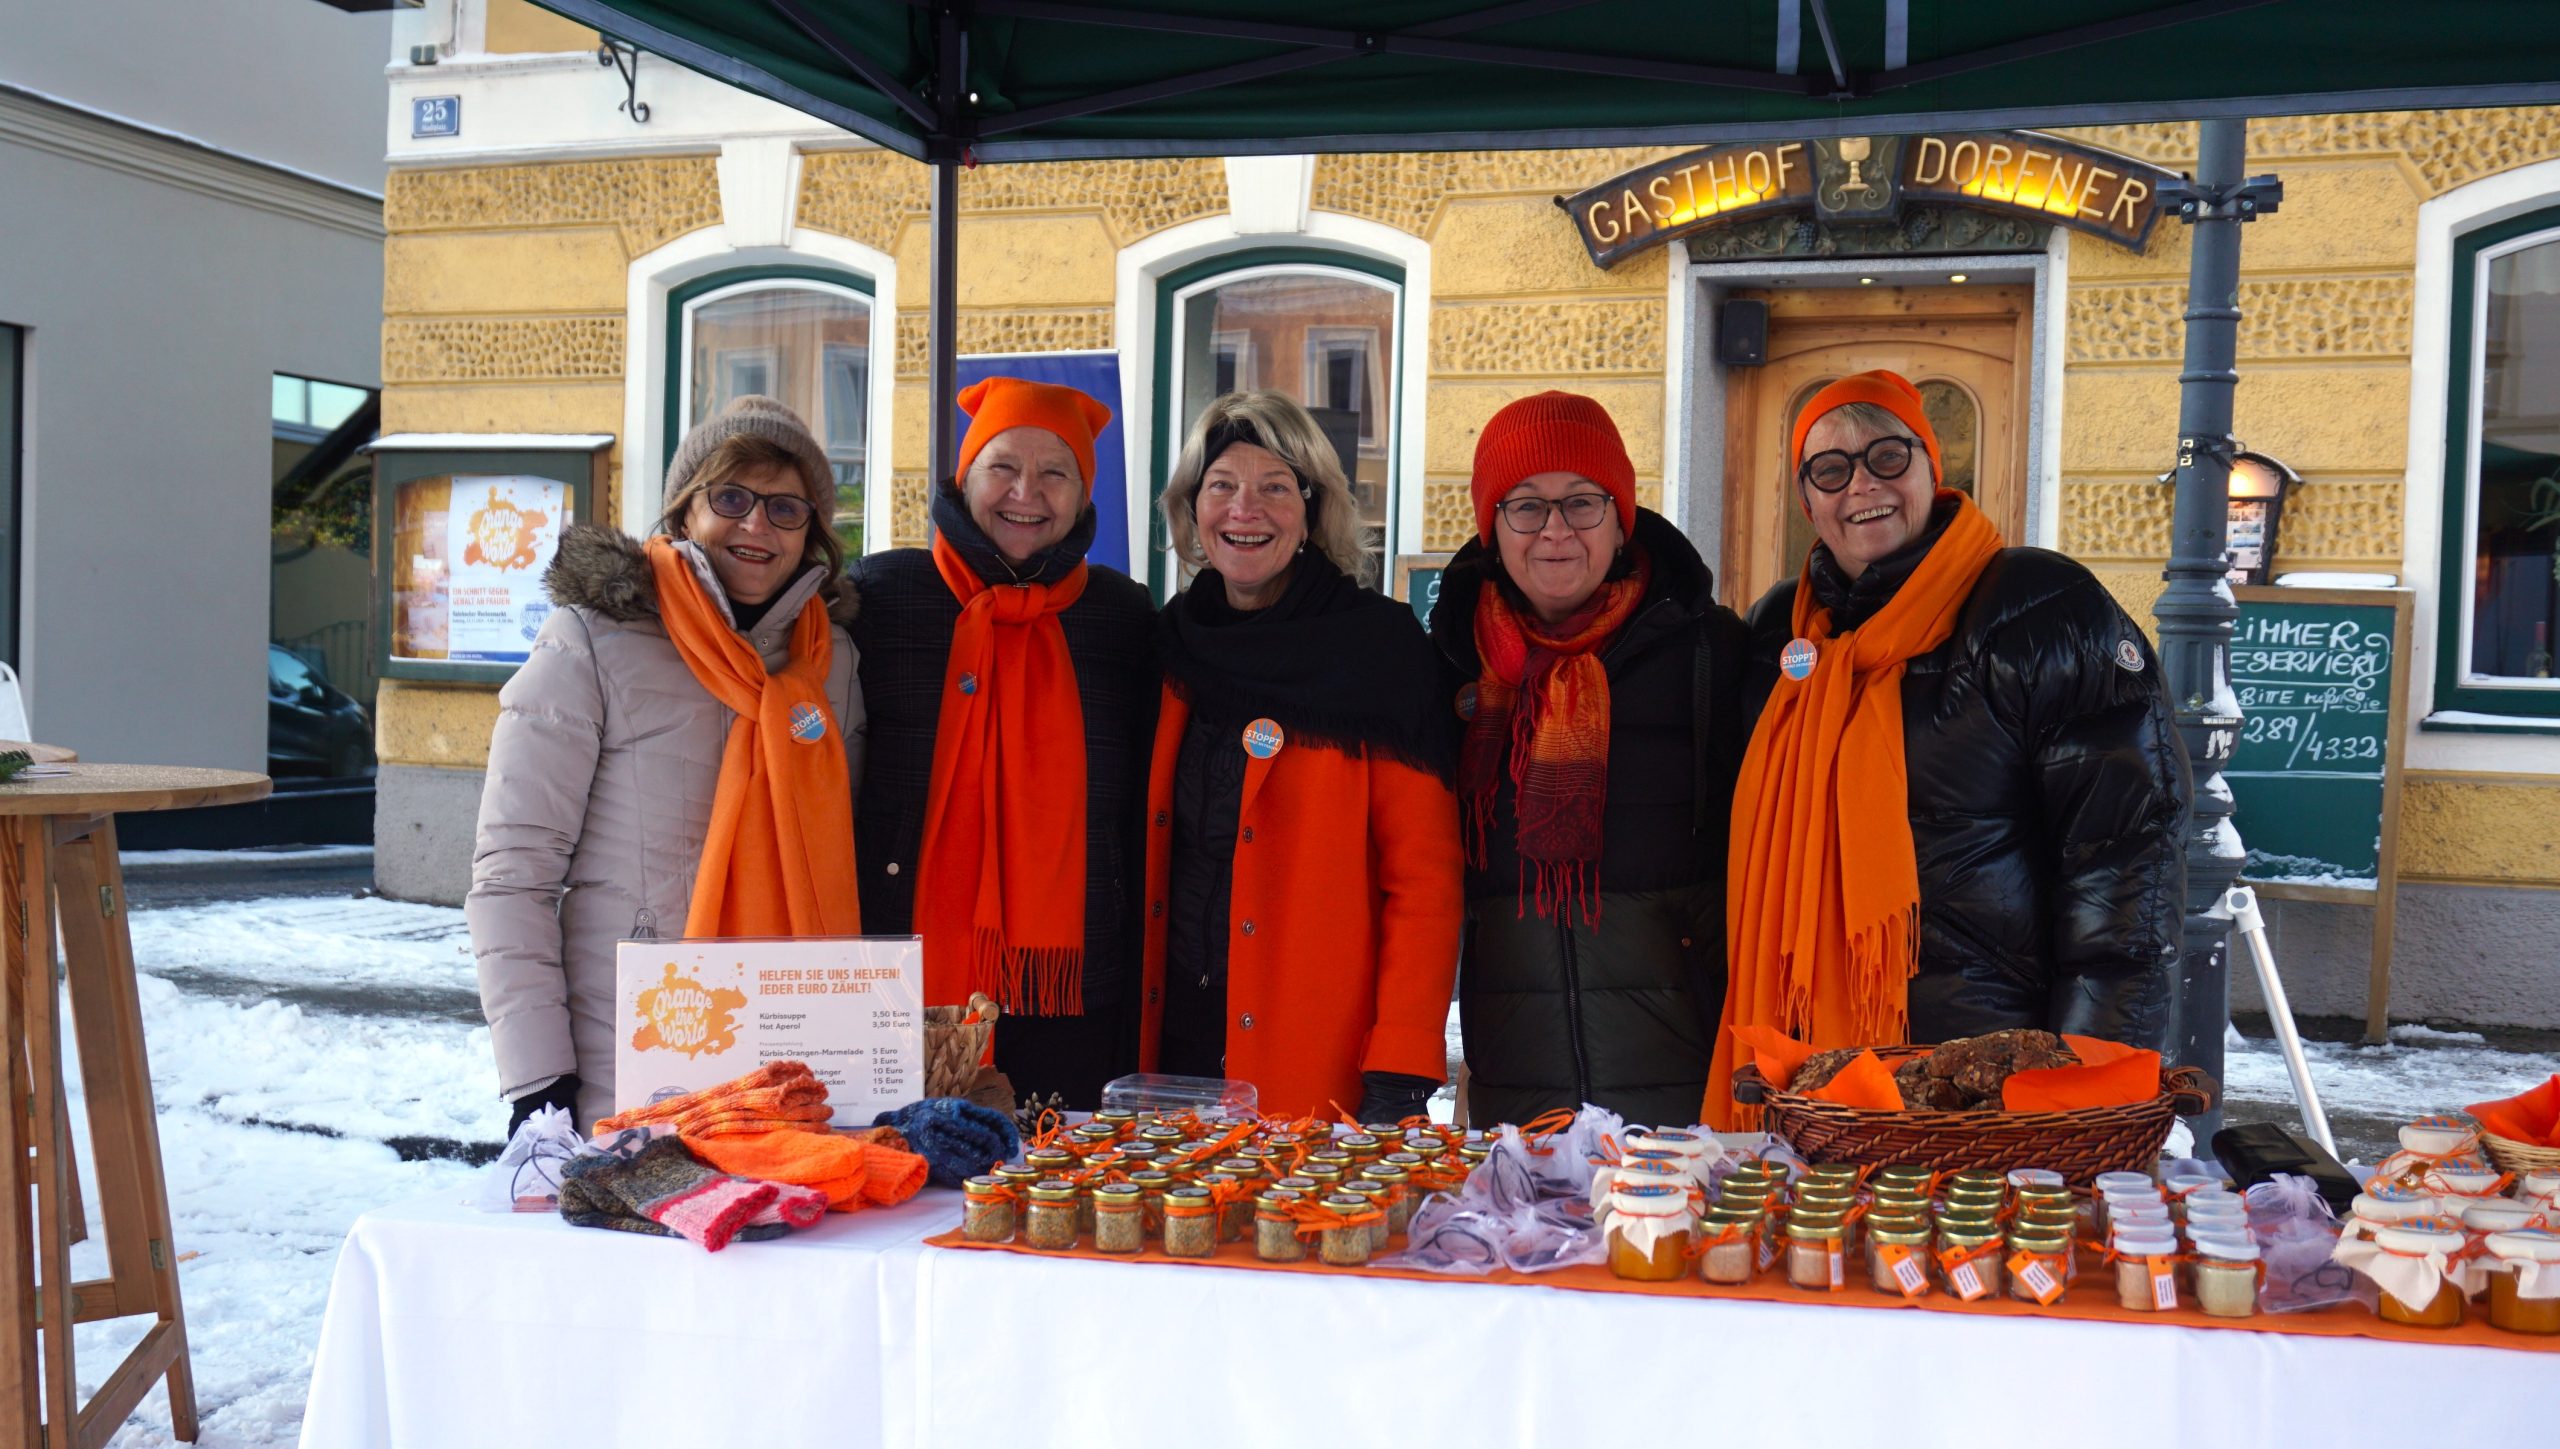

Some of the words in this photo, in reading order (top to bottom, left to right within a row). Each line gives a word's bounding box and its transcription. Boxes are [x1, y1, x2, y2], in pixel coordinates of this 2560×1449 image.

[422, 100, 448, 122] 25
[1588, 143, 1802, 243] GASTHOF
[1915, 137, 2149, 229] DORFNER
[2230, 617, 2360, 651] iMMER
[1783, 653, 1814, 665] STOPPT
[1459, 696, 1477, 708] STOP
[790, 709, 822, 735] STOPPT
[1246, 729, 1281, 746] STOPPT
[759, 970, 802, 981] HELFEN
[806, 969, 824, 980] SIE
[828, 969, 850, 980] UNS
[854, 968, 900, 980] HELFEN!
[759, 983, 794, 995] JEDER
[798, 983, 828, 994] EURO
[831, 980, 871, 994] ZÄHLT!
[653, 987, 713, 1020] Orange
[674, 1009, 697, 1026] the
[759, 1012, 807, 1021] Kürbissuppe
[872, 1011, 890, 1019] 3,50
[892, 1010, 910, 1018] Euro
[657, 1019, 707, 1046] World
[775, 1023, 801, 1031] Aperol
[872, 1021, 890, 1029] 3,50
[892, 1020, 910, 1028] Euro
[759, 1049, 864, 1058] Kürbis-Orangen-Marmelade
[815, 1069, 842, 1077] hänger
